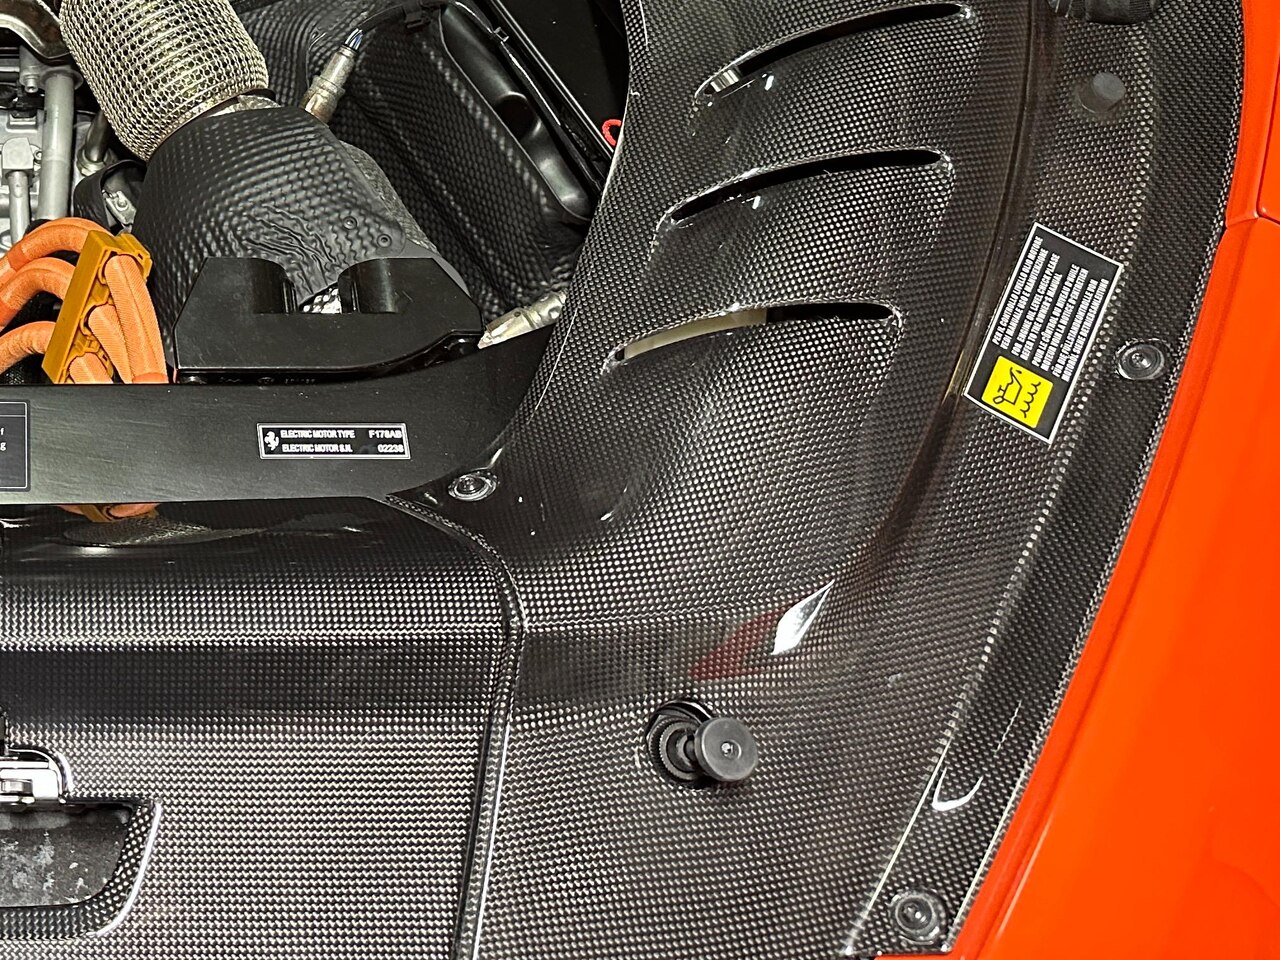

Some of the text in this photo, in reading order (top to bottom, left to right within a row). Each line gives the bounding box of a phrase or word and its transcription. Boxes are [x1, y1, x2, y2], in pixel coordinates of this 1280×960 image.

[280, 429, 312, 438] ELECTRIC
[313, 429, 337, 438] MOTOR
[337, 429, 356, 438] TYPE
[282, 443, 314, 452] ELECTRIC
[314, 443, 339, 452] MOTOR
